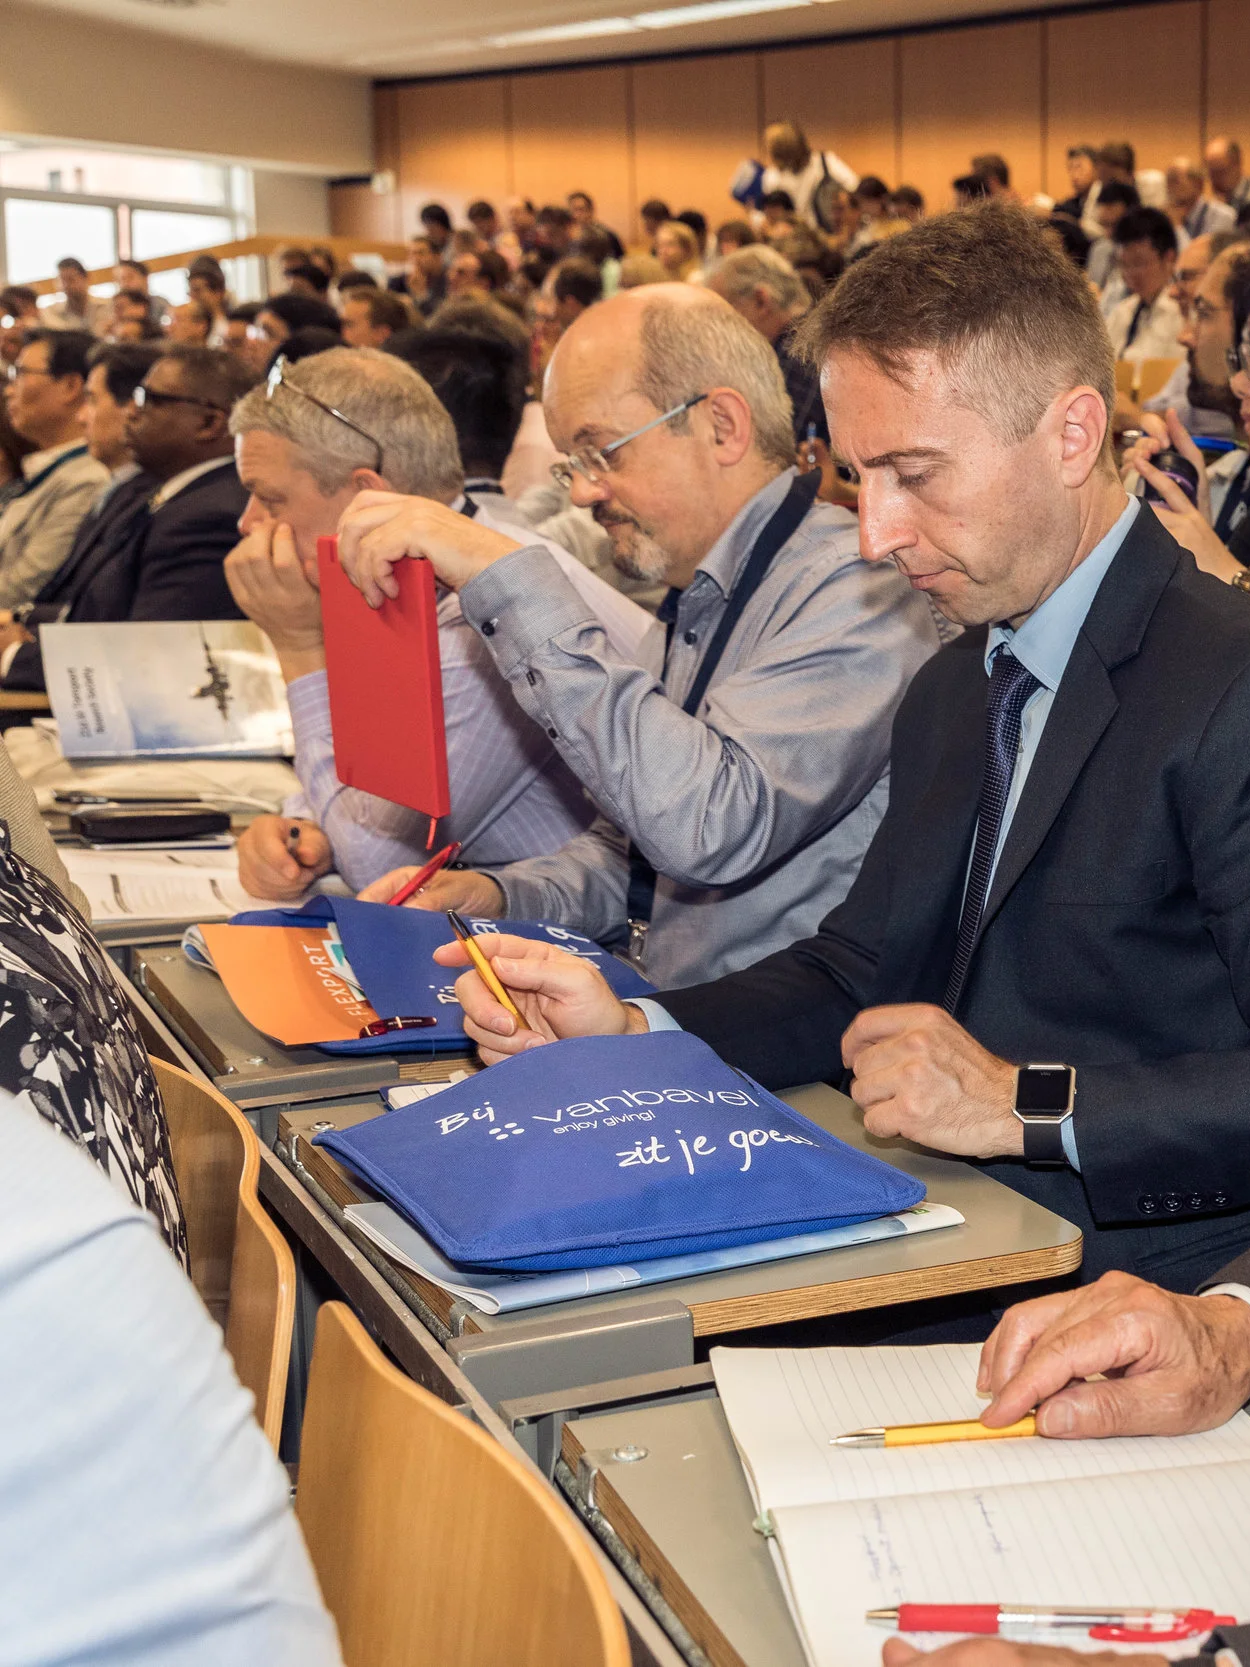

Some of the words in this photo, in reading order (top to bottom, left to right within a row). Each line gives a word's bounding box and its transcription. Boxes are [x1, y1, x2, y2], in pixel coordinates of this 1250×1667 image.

[303, 944, 369, 1017] FLEXPORT
[433, 1101, 496, 1136] Bij
[531, 1088, 760, 1123] vanbavel
[552, 1119, 599, 1135] enjoy
[602, 1109, 657, 1127] giving!
[615, 1136, 671, 1168] zit
[674, 1129, 717, 1176] je
